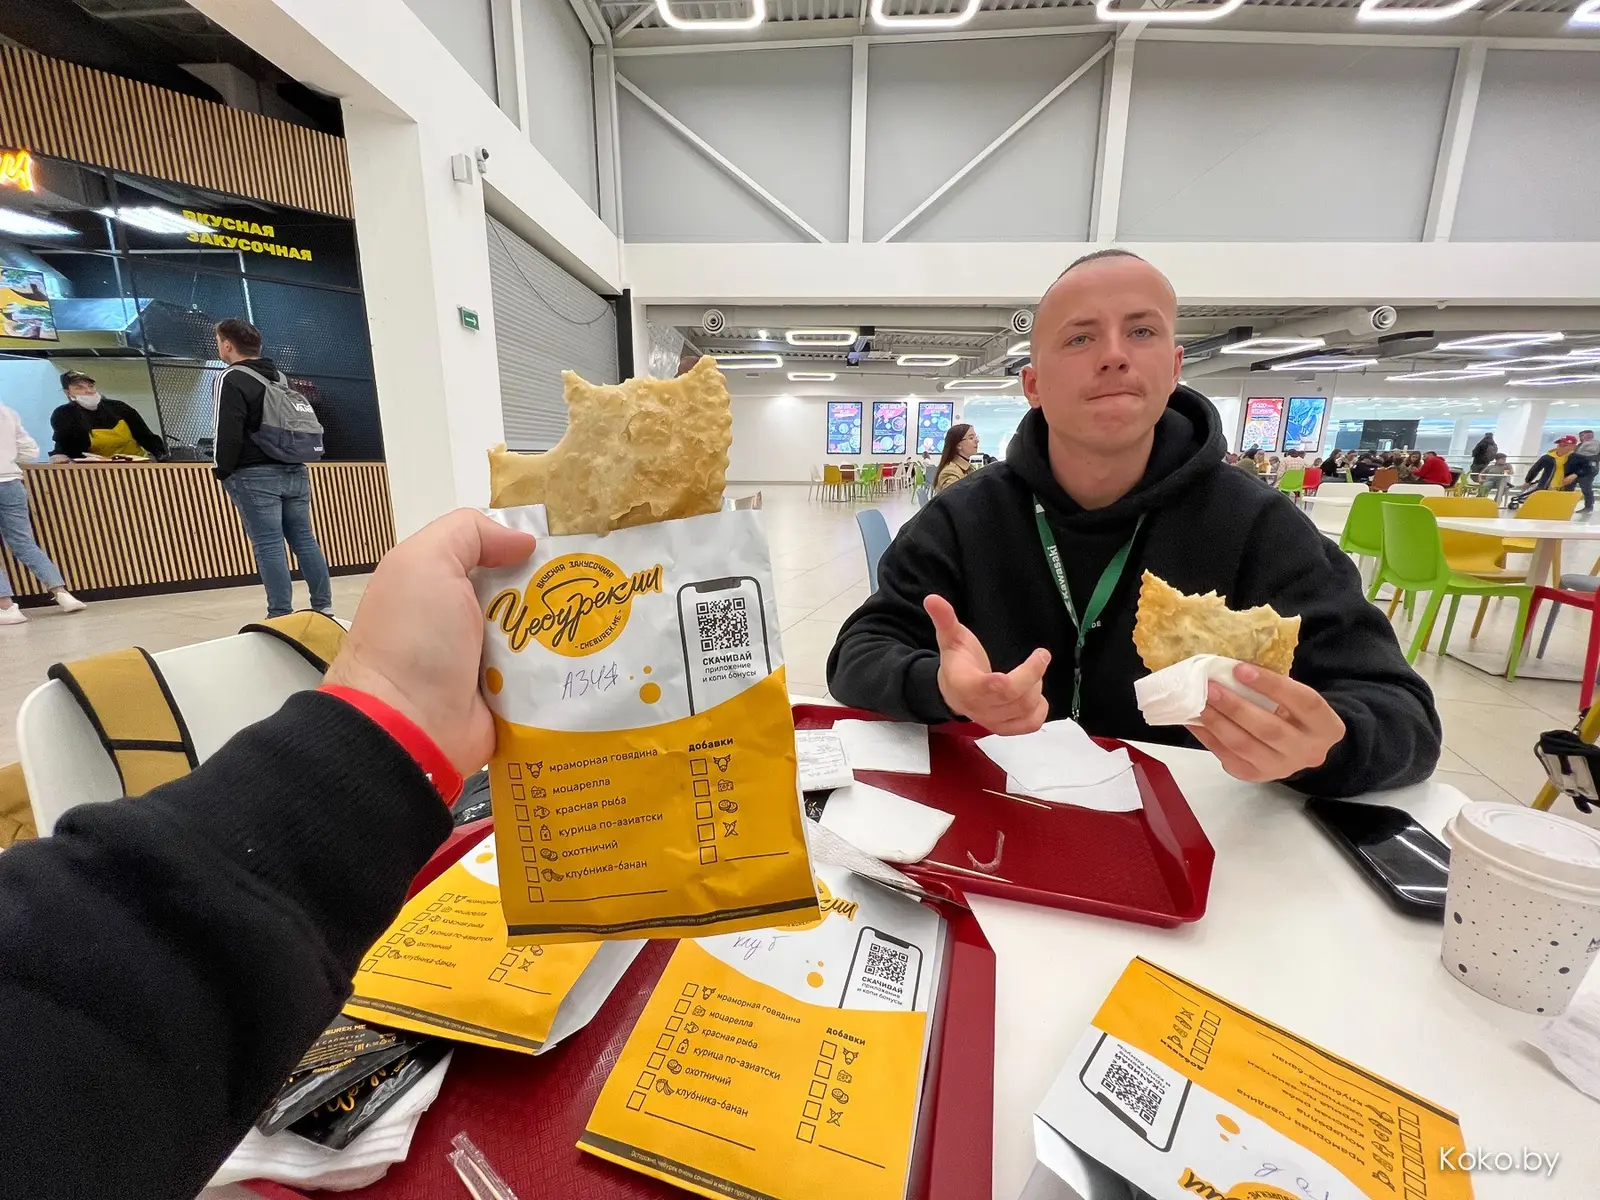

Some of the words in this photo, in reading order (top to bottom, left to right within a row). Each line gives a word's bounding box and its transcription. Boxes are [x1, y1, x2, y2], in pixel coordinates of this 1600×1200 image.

[182, 210, 275, 238] ВКУСНАЯ
[187, 232, 312, 262] ЗАКУСОЧНАЯ
[536, 564, 566, 589] ВКУСНАЯ
[569, 561, 615, 579] ЗАКУСОЧНАЯ
[703, 650, 752, 666] СКАЧИВАЙ
[705, 662, 751, 674] приложение
[709, 674, 727, 682] копи
[728, 670, 757, 679] бонусы
[688, 738, 734, 752] добавки
[550, 756, 608, 772] мраморная
[610, 748, 658, 762] говядина
[552, 777, 611, 794] моцарелла
[555, 801, 599, 816] красная
[601, 796, 627, 808] рыба
[558, 822, 597, 838] курица
[600, 812, 663, 829] по-азиатски
[562, 840, 619, 858] охотничий
[565, 859, 647, 879] клубника-банан
[862, 976, 903, 994] СКАЧИВАЙ
[717, 993, 760, 1009] мраморная
[762, 1005, 801, 1024] говядина
[709, 1011, 754, 1027] моцарелла
[702, 1028, 735, 1042] красная
[736, 1037, 758, 1049] рыба
[826, 1027, 866, 1046] добавки
[693, 1047, 723, 1061] курица
[725, 1055, 781, 1080] по-азиатски
[685, 1067, 732, 1086] охотничий
[676, 1087, 748, 1117] клубника-банан
[1236, 1088, 1291, 1121] говядина
[1294, 1120, 1365, 1166] мраморная
